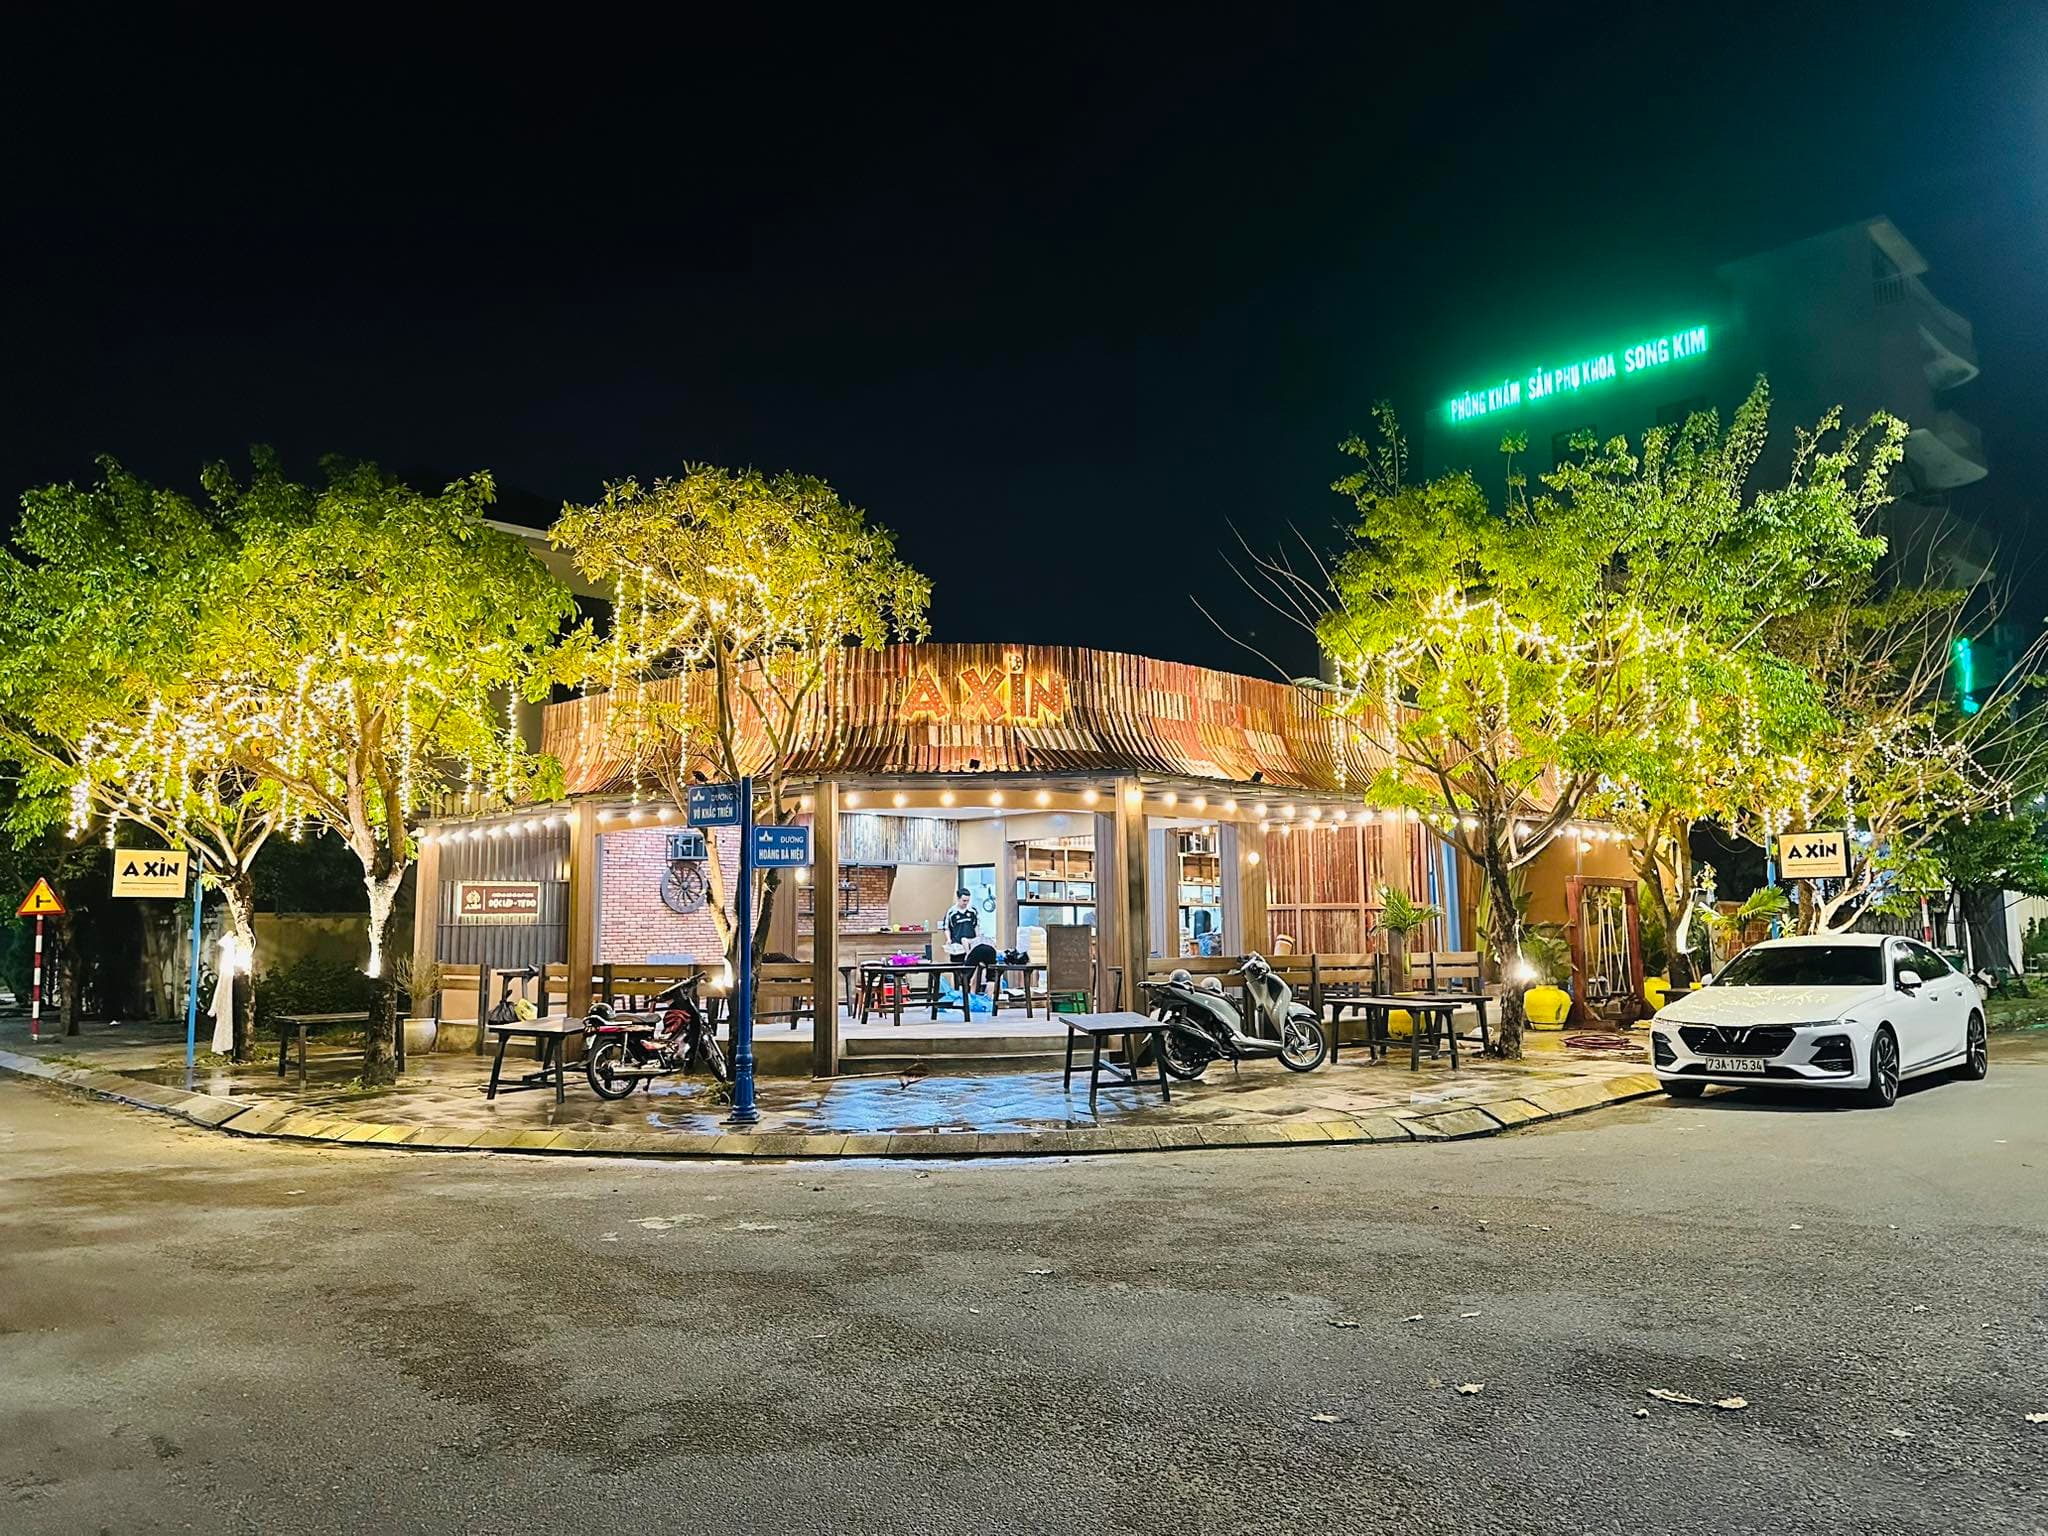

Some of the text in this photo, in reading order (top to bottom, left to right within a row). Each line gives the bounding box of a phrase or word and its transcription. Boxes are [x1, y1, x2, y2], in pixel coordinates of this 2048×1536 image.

[1488, 379, 1520, 411] KHÁM
[1555, 364, 1580, 391] PHỤ
[1582, 353, 1616, 384] KHOA
[1624, 338, 1669, 373] SONG
[1672, 327, 1707, 359] KIM
[1788, 838, 1837, 859] A XỈN
[122, 856, 180, 877] A XỈN
